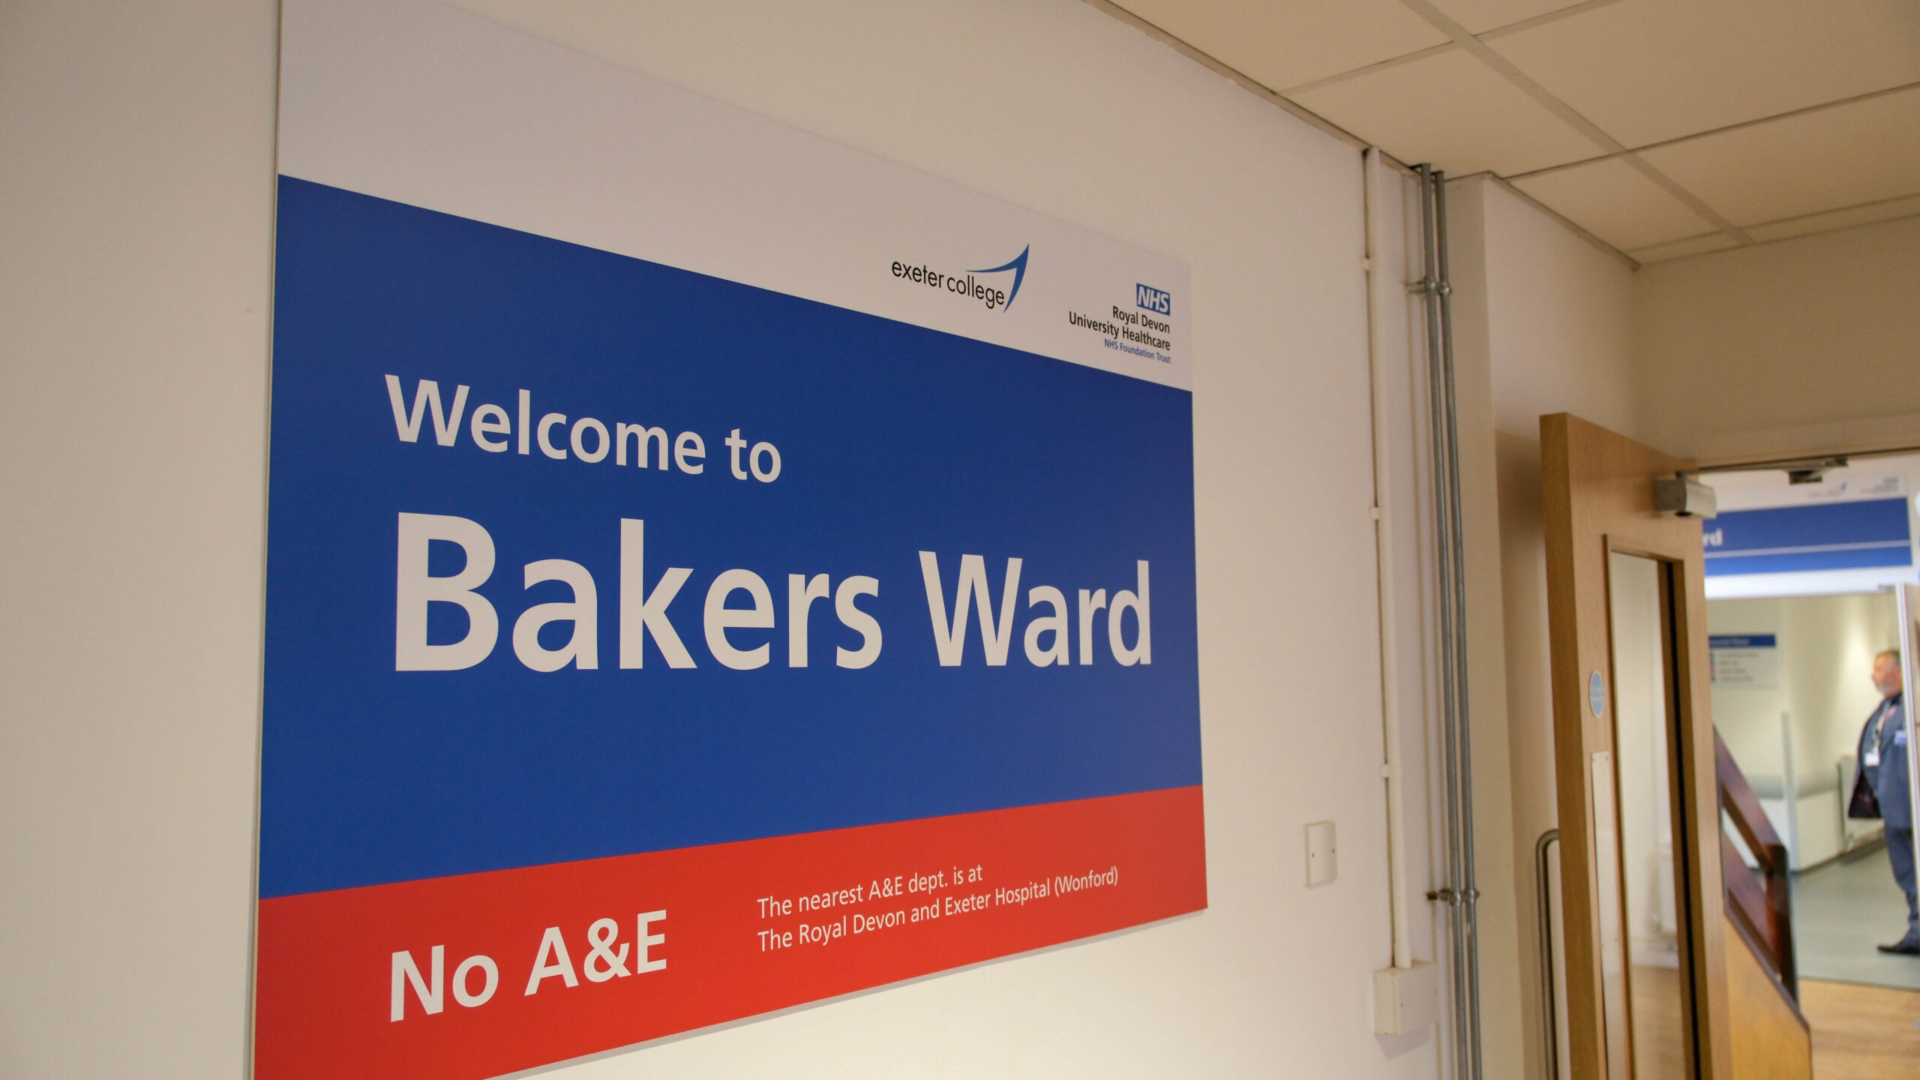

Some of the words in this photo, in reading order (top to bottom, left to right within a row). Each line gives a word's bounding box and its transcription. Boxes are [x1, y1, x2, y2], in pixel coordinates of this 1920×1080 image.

[891, 261, 945, 289] exeter
[947, 275, 1005, 309] college
[1136, 285, 1170, 315] NHS
[1068, 310, 1120, 339] University
[1121, 324, 1171, 352] Healthcare
[1112, 305, 1139, 325] Royal
[1141, 313, 1171, 334] Devon
[1103, 337, 1119, 351] NHS
[1119, 341, 1155, 360] Foundation
[1156, 350, 1171, 365] Trust
[385, 374, 706, 475] Welcome
[724, 428, 782, 484] to
[395, 511, 882, 672] Bakers
[918, 550, 1152, 668] Ward
[757, 896, 793, 919] The
[798, 884, 864, 913] nearest
[868, 876, 904, 901] A&E
[908, 870, 948, 895] dept.
[953, 867, 964, 886] is
[967, 864, 983, 883] at
[757, 929, 793, 952] The
[799, 915, 848, 946] Royal
[853, 911, 906, 935] Devon
[910, 898, 940, 923] and
[944, 893, 991, 916] Exeter
[995, 877, 1051, 906] Hospital
[1054, 866, 1119, 898] (Wonford)
[390, 944, 500, 1023] No
[523, 909, 668, 997] A&E
